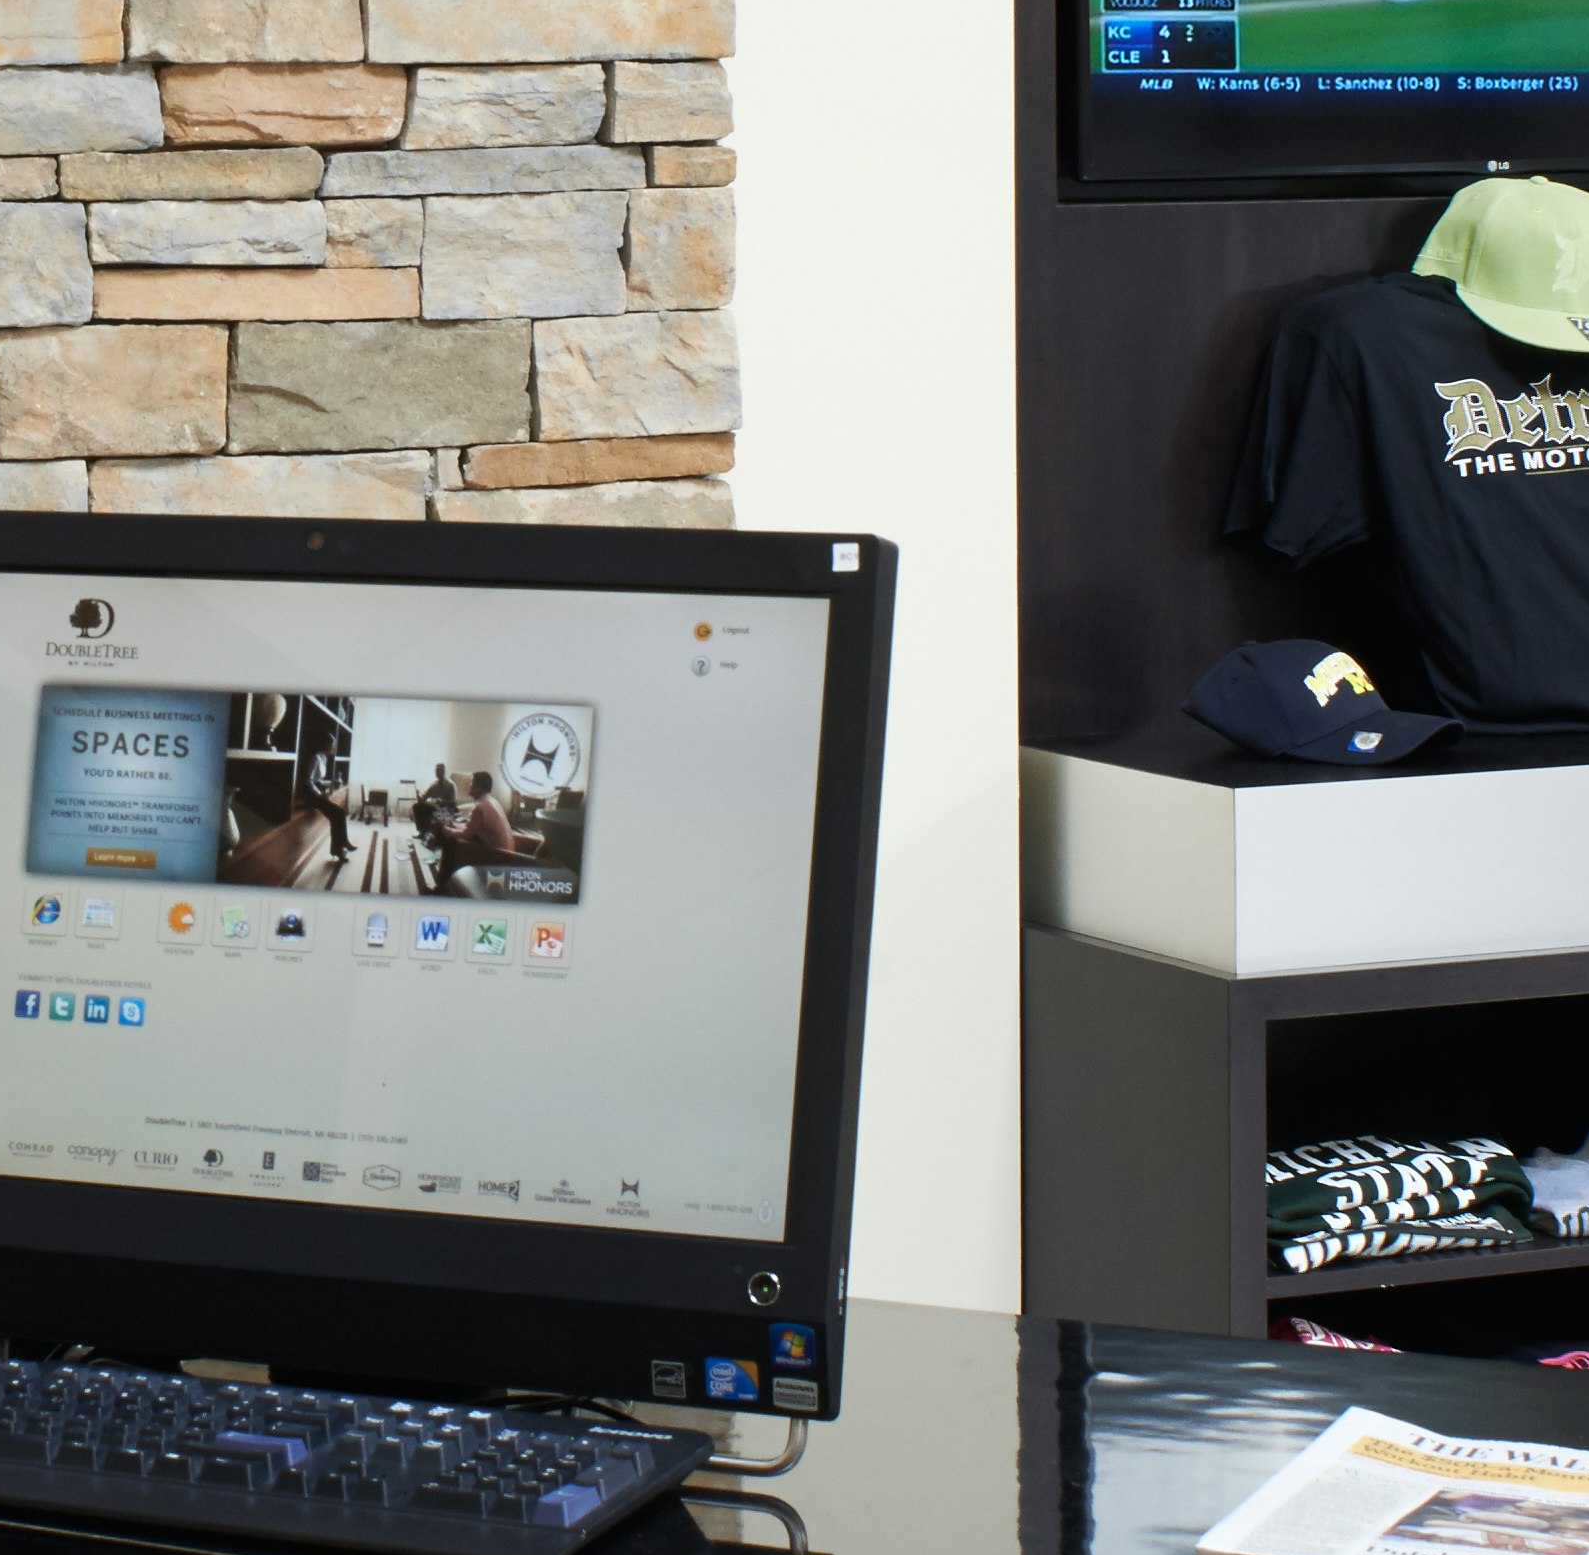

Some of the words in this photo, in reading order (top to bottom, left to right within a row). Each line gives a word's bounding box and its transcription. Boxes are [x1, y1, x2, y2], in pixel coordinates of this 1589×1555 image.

[1108, 25, 1131, 40] KC
[1158, 25, 1170, 39] 4
[1186, 24, 1194, 36] 2
[1108, 51, 1140, 64] CLE
[1162, 51, 1170, 64] 1
[1140, 79, 1173, 90] MLB
[1197, 78, 1216, 91] W:
[1220, 77, 1260, 91] Karns
[1263, 76, 1300, 92] (6-5)
[1318, 78, 1330, 91] L:
[1335, 77, 1392, 91] Sanchez
[1396, 76, 1440, 92] (10-8)
[1457, 77, 1471, 91] S:
[1476, 77, 1544, 94] Boxberger
[1548, 76, 1578, 92] (25)
[1453, 453, 1516, 477] THE
[53, 706, 102, 719] SCHEDULE
[105, 707, 148, 720] BUSINESS
[150, 710, 201, 723] MEETINGS
[204, 712, 215, 722] IN
[72, 730, 190, 760] SPACES
[84, 767, 115, 779] YOU'D
[118, 769, 155, 781] RATHER
[158, 770, 173, 781] BE.
[55, 796, 87, 809] HILTON
[142, 800, 199, 814] TRANSFORMS
[51, 809, 83, 820] POINTS
[85, 810, 104, 821] INTO
[106, 811, 152, 824] MEMORIES
[155, 814, 173, 825] YOU
[175, 815, 201, 826] CAN'T
[89, 821, 110, 832] HELP
[112, 823, 129, 834] BUT
[94, 852, 115, 863] Learn
[117, 854, 136, 863] more
[510, 871, 541, 881] HILTON
[508, 879, 573, 894] HHONORS
[9, 1141, 54, 1153] CONRAD
[134, 1151, 178, 1165] CURIO
[1410, 1433, 1494, 1459] THE
